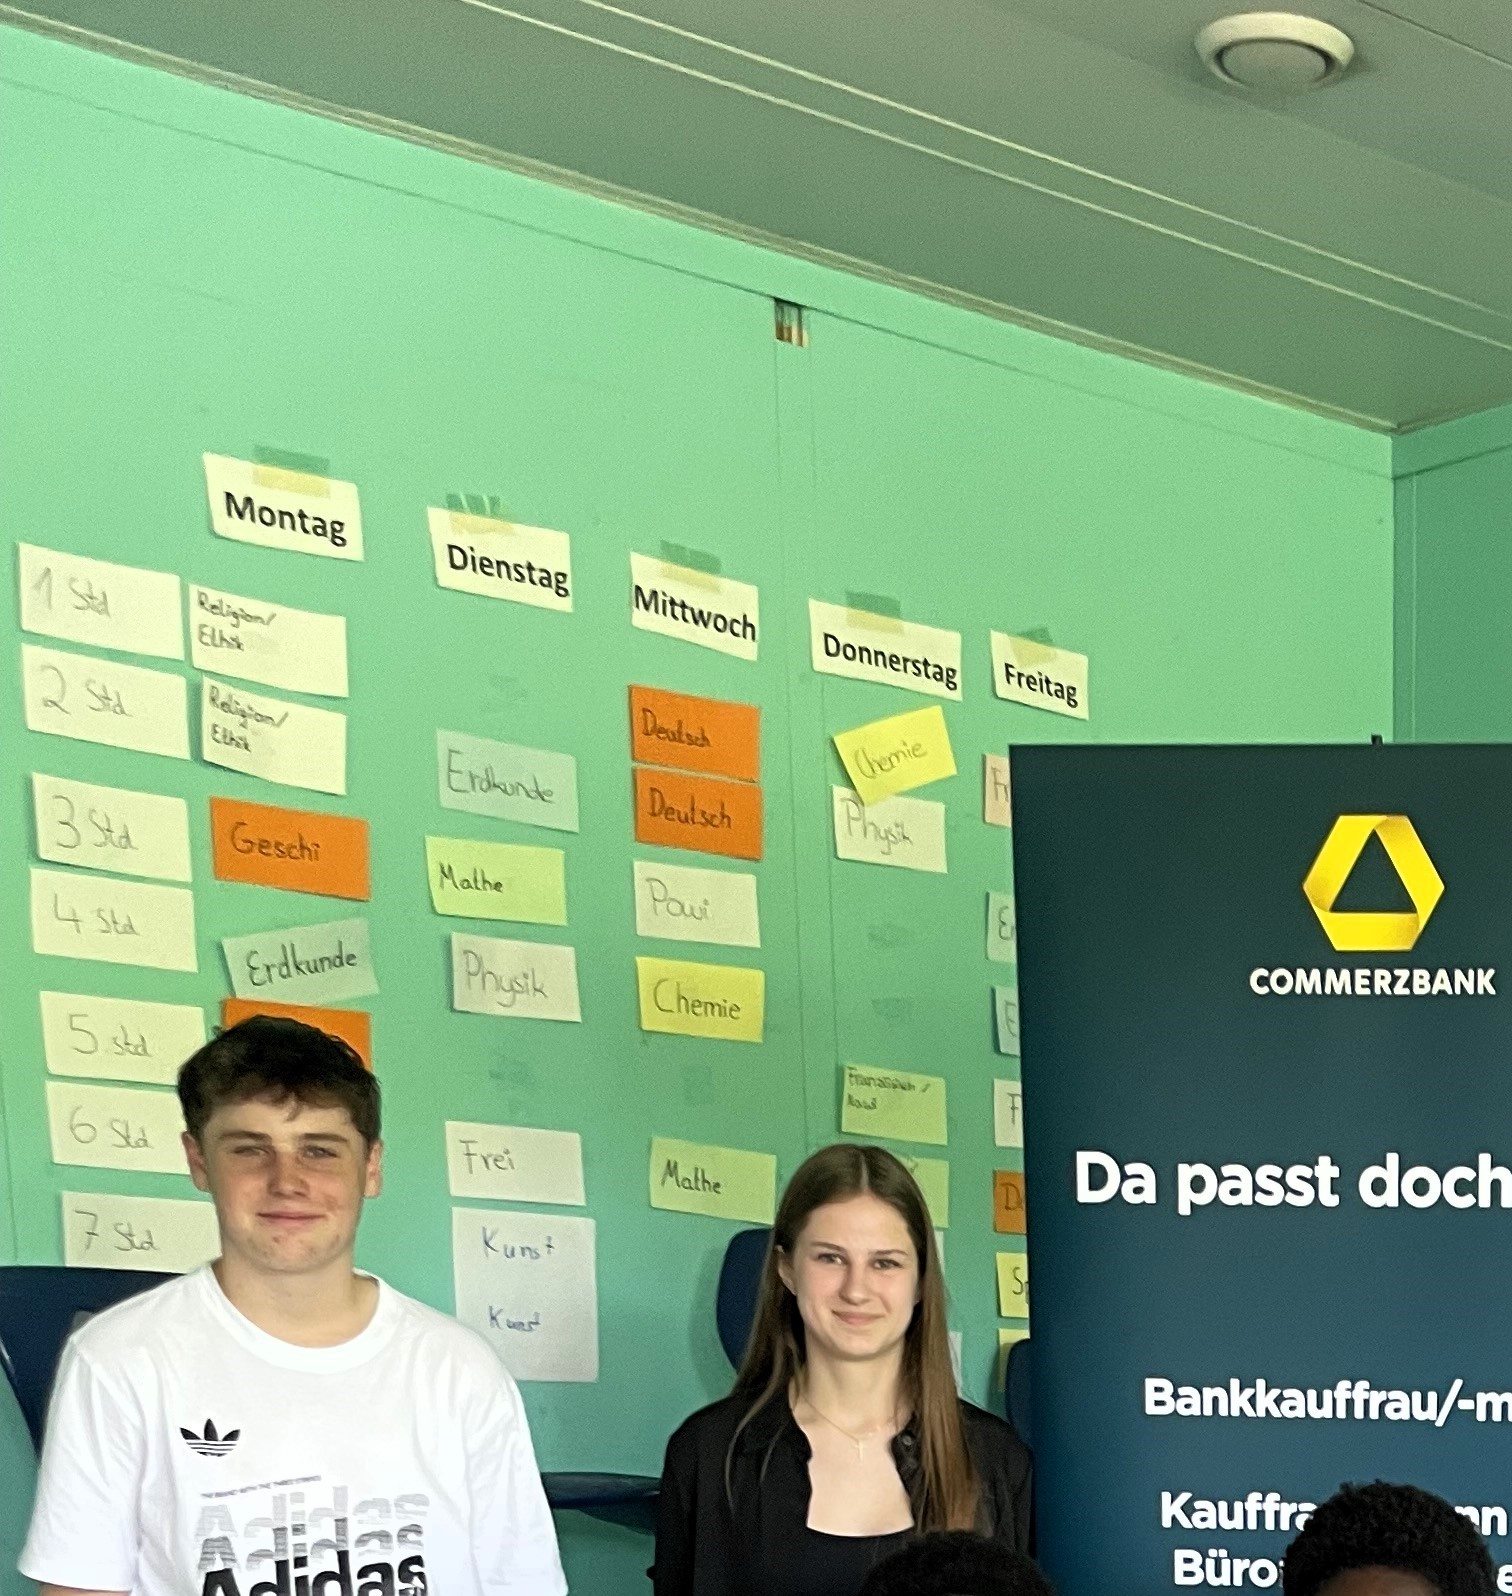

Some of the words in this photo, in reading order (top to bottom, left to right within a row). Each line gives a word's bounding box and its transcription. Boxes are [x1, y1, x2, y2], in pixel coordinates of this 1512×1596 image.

[225, 490, 348, 547] Montag
[33, 567, 53, 611] 1
[68, 576, 111, 618] Std
[447, 543, 571, 597] Dienstag
[633, 584, 757, 643] Mittwoch
[822, 631, 958, 691] Donnerstag
[41, 664, 71, 716] 2
[85, 678, 133, 718] Std
[1004, 662, 1079, 709] Freitag
[641, 708, 712, 749] Deutsch
[447, 748, 555, 804] Erdkunde
[853, 739, 929, 781] Chemie
[52, 794, 81, 849] 3
[88, 808, 138, 851] Std
[648, 787, 732, 830] Deutsch
[841, 795, 914, 857] Physik
[230, 820, 321, 864] Geschi
[438, 861, 505, 894] Mathe
[54, 892, 84, 934] 4
[96, 907, 140, 936] Std
[246, 940, 359, 988] Erdkunde
[461, 949, 549, 1008] Physik
[1249, 966, 1498, 998] COMMERZBANK
[652, 977, 741, 1022] Chemie
[70, 1013, 99, 1054] 5
[69, 1105, 98, 1145] 6
[110, 1118, 153, 1150] Std
[459, 1138, 516, 1173] Frei
[660, 1158, 723, 1196] Mathe
[1075, 1150, 1157, 1206] Da
[1177, 1154, 1341, 1218] passt
[74, 1208, 99, 1252] 7
[113, 1221, 158, 1252] Std
[482, 1225, 555, 1261] Kunst
